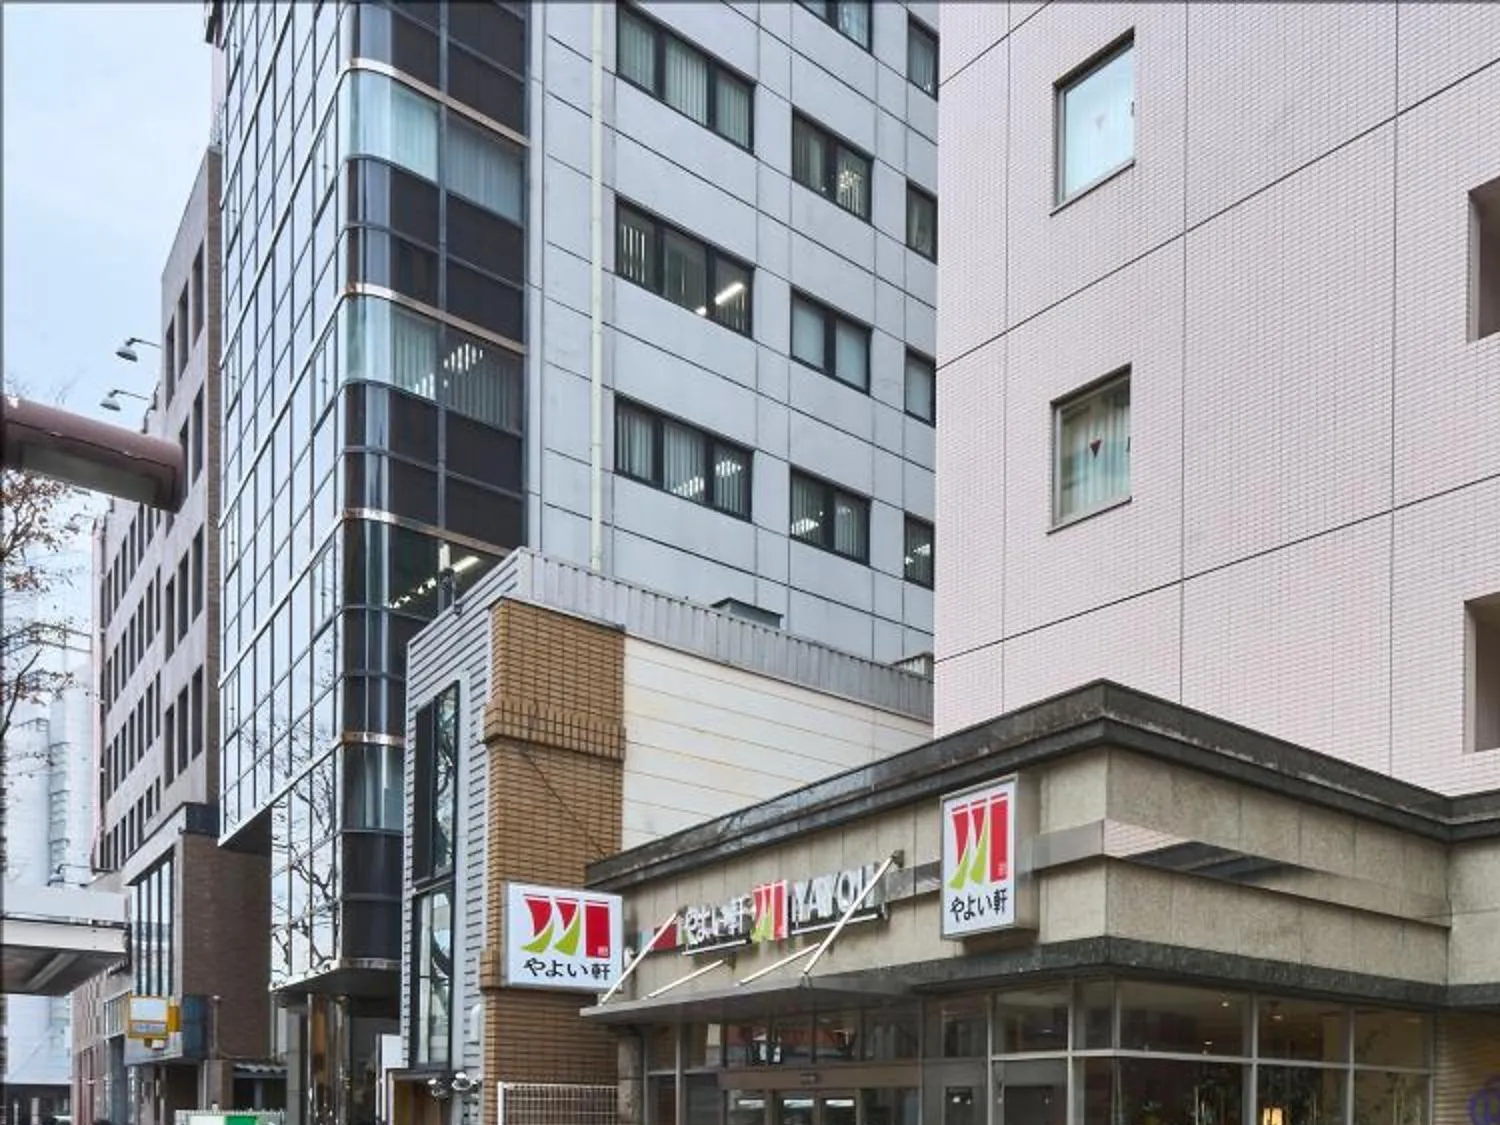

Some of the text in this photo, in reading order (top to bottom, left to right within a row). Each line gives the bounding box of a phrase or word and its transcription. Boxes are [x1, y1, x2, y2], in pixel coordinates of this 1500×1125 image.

[951, 888, 1008, 922] やよい軒
[523, 957, 611, 980] やよい軒
